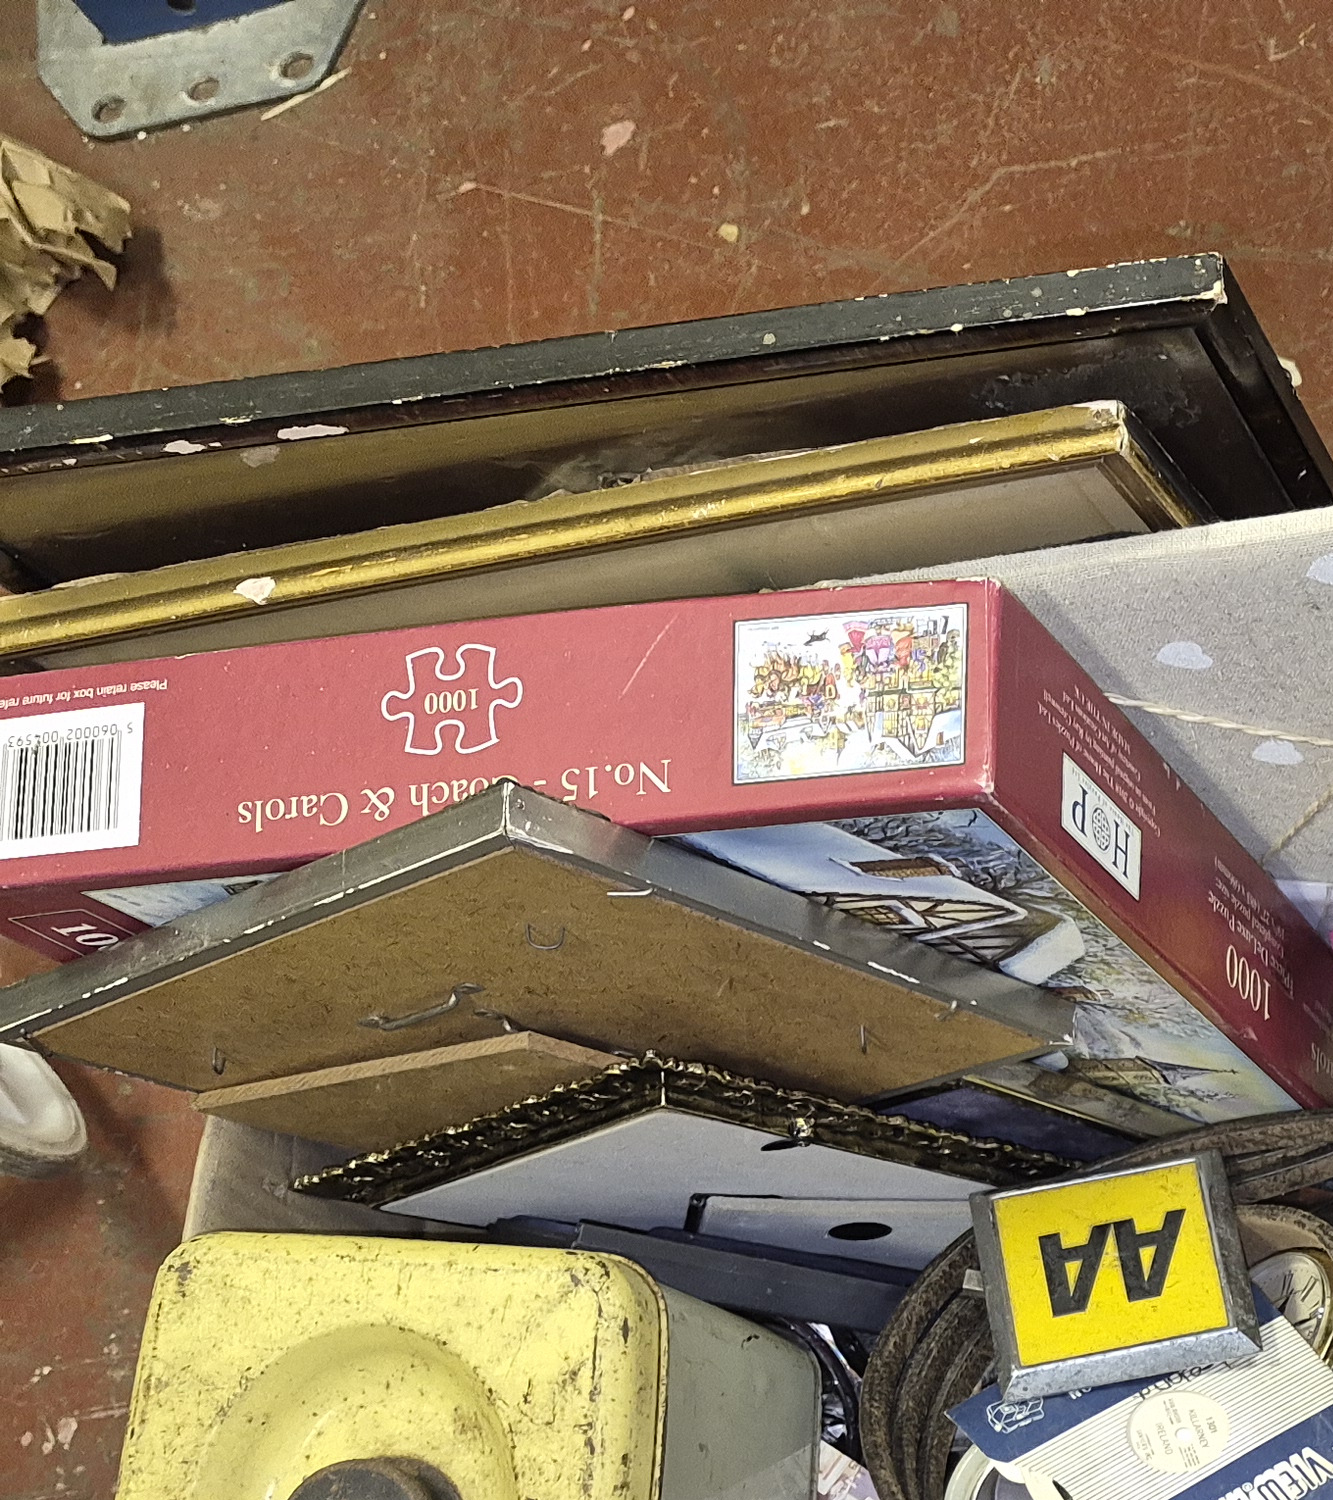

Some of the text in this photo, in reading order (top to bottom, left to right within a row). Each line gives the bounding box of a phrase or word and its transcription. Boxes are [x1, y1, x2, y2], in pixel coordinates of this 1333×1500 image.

[22, 692, 52, 706] future
[55, 690, 70, 702] for
[73, 687, 93, 699] box
[96, 683, 126, 697] retain
[130, 678, 167, 692] Please
[423, 685, 480, 716] 1000
[66, 723, 117, 740] 060002
[408, 774, 520, 817] oach
[559, 758, 671, 802] No.15
[234, 791, 349, 833] Carols
[358, 786, 395, 823] &
[1208, 888, 1234, 932] Puzzle
[1225, 943, 1271, 1020] 1000
[1038, 1208, 1186, 1319] AA
[1155, 1422, 1174, 1456] IRELAND
[1188, 1408, 1211, 1449] KILLARNEY
